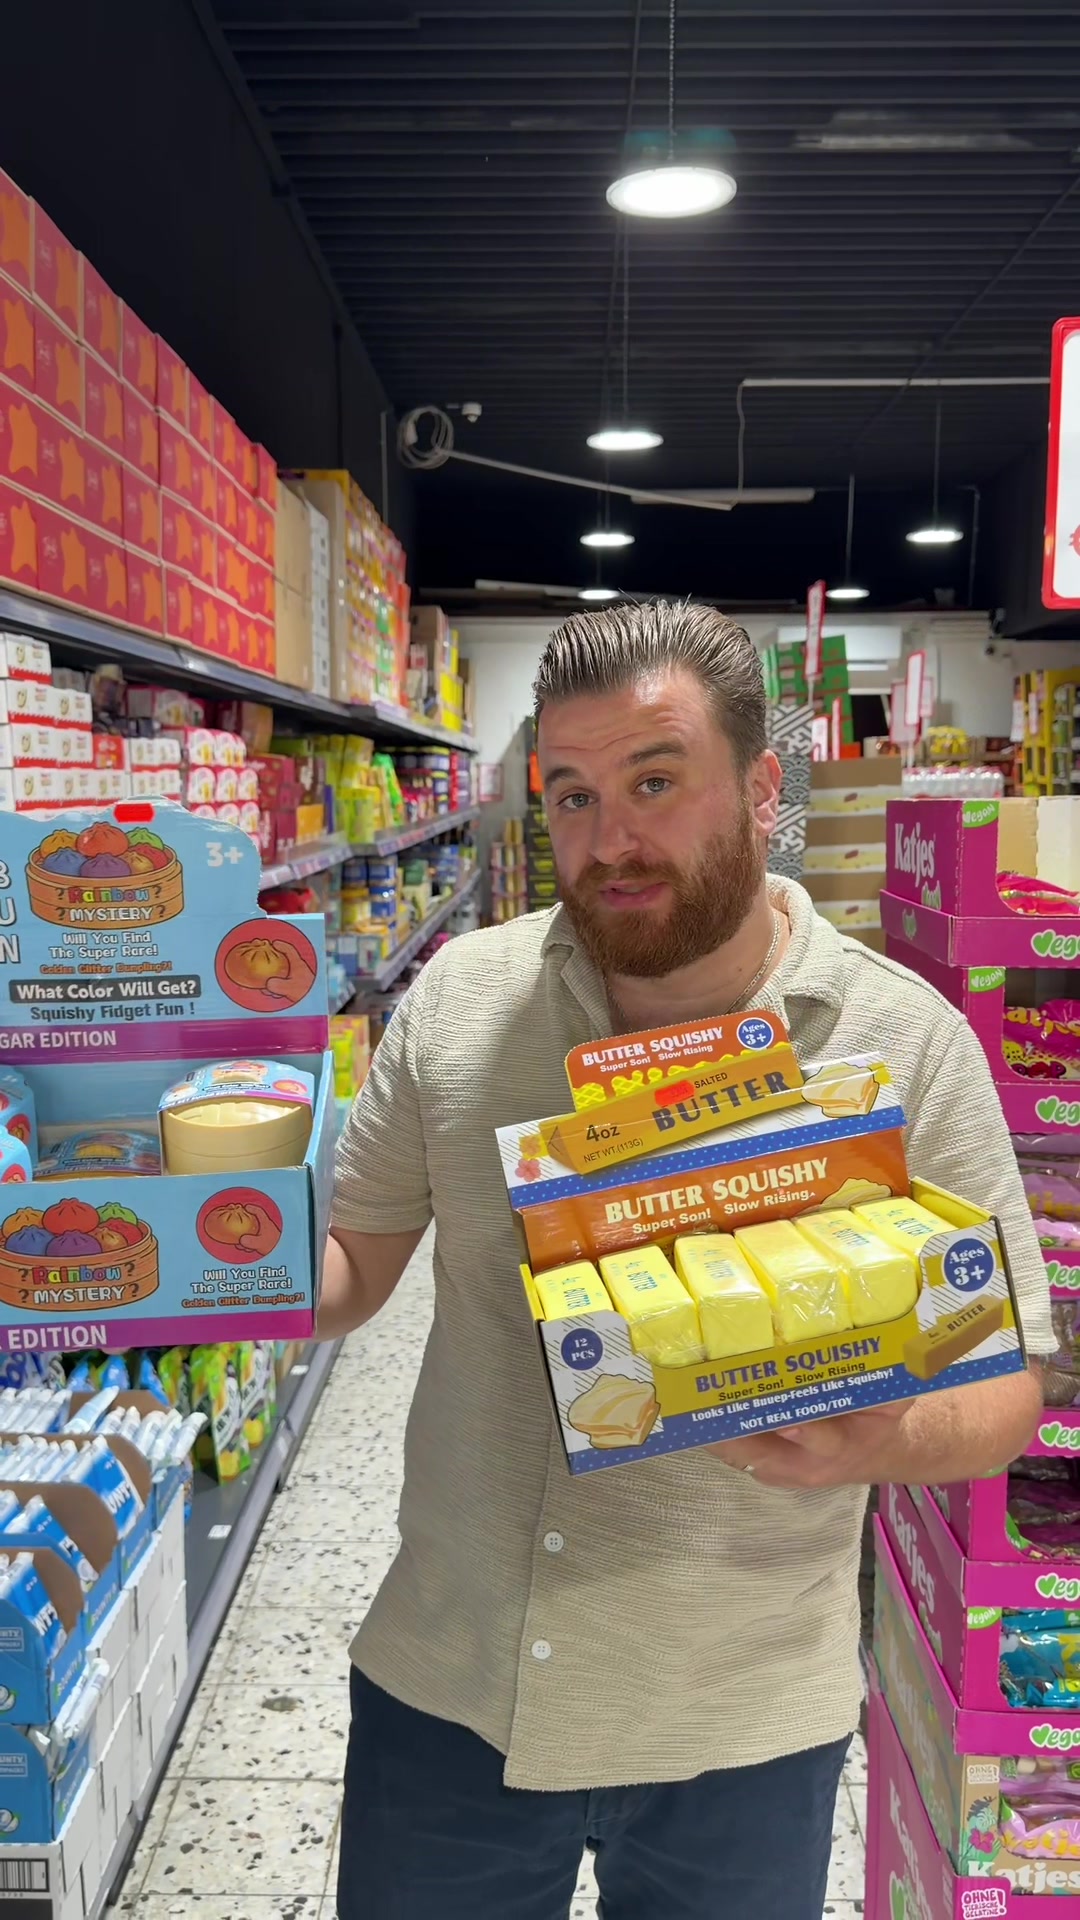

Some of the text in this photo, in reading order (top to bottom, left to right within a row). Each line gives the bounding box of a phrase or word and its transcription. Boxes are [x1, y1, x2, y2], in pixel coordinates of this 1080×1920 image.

[206, 842, 243, 867] 3+
[894, 822, 935, 888] Katjes
[68, 886, 149, 904] Rainbow
[69, 907, 153, 922] MYSTERY
[62, 931, 152, 945] Will You Find
[49, 945, 159, 960] The Super Rare!
[16, 980, 196, 999] What Color Will Get?
[30, 1005, 95, 1022] Squishy
[101, 1003, 152, 1021] Fidget
[156, 1003, 184, 1016] Fun
[742, 1023, 766, 1034] Ages
[40, 1030, 117, 1048] EDITION
[582, 1027, 723, 1067] BUTTER SQUISHY
[745, 1033, 767, 1045] 3+
[600, 1044, 713, 1073] Super Son! Slow Rising
[694, 1072, 728, 1089] SALTED
[652, 1071, 791, 1132] BUTTER
[586, 1124, 620, 1142] 4oz
[583, 1151, 601, 1164] NET
[604, 1157, 828, 1224] BUTTER SQUISHY
[632, 1189, 809, 1234] Super Son! Slow Rising
[949, 1247, 985, 1265] Ages
[32, 1264, 121, 1285] Rainbow
[204, 1265, 286, 1281] Will You Find
[953, 1265, 985, 1285] 3+
[191, 1277, 292, 1294] The Super Rare!
[33, 1286, 126, 1305] MYSTERY
[181, 1298, 216, 1308] Golden
[217, 1296, 250, 1306] Glitter
[946, 1303, 986, 1332] BUTTER
[7, 1324, 107, 1350] EDITION
[574, 1337, 588, 1349] 12
[571, 1349, 596, 1362] PCS
[695, 1336, 881, 1393] BUTTER SQUISHY
[718, 1362, 866, 1401] Super Son! Slow Rising
[691, 1408, 724, 1422] Looks
[726, 1400, 750, 1414] Like
[822, 1377, 845, 1391] Like
[847, 1367, 894, 1386] Squishy!
[740, 1397, 854, 1431] NOT REAL FOOD/TOY
[964, 1890, 996, 1904] OHNE
